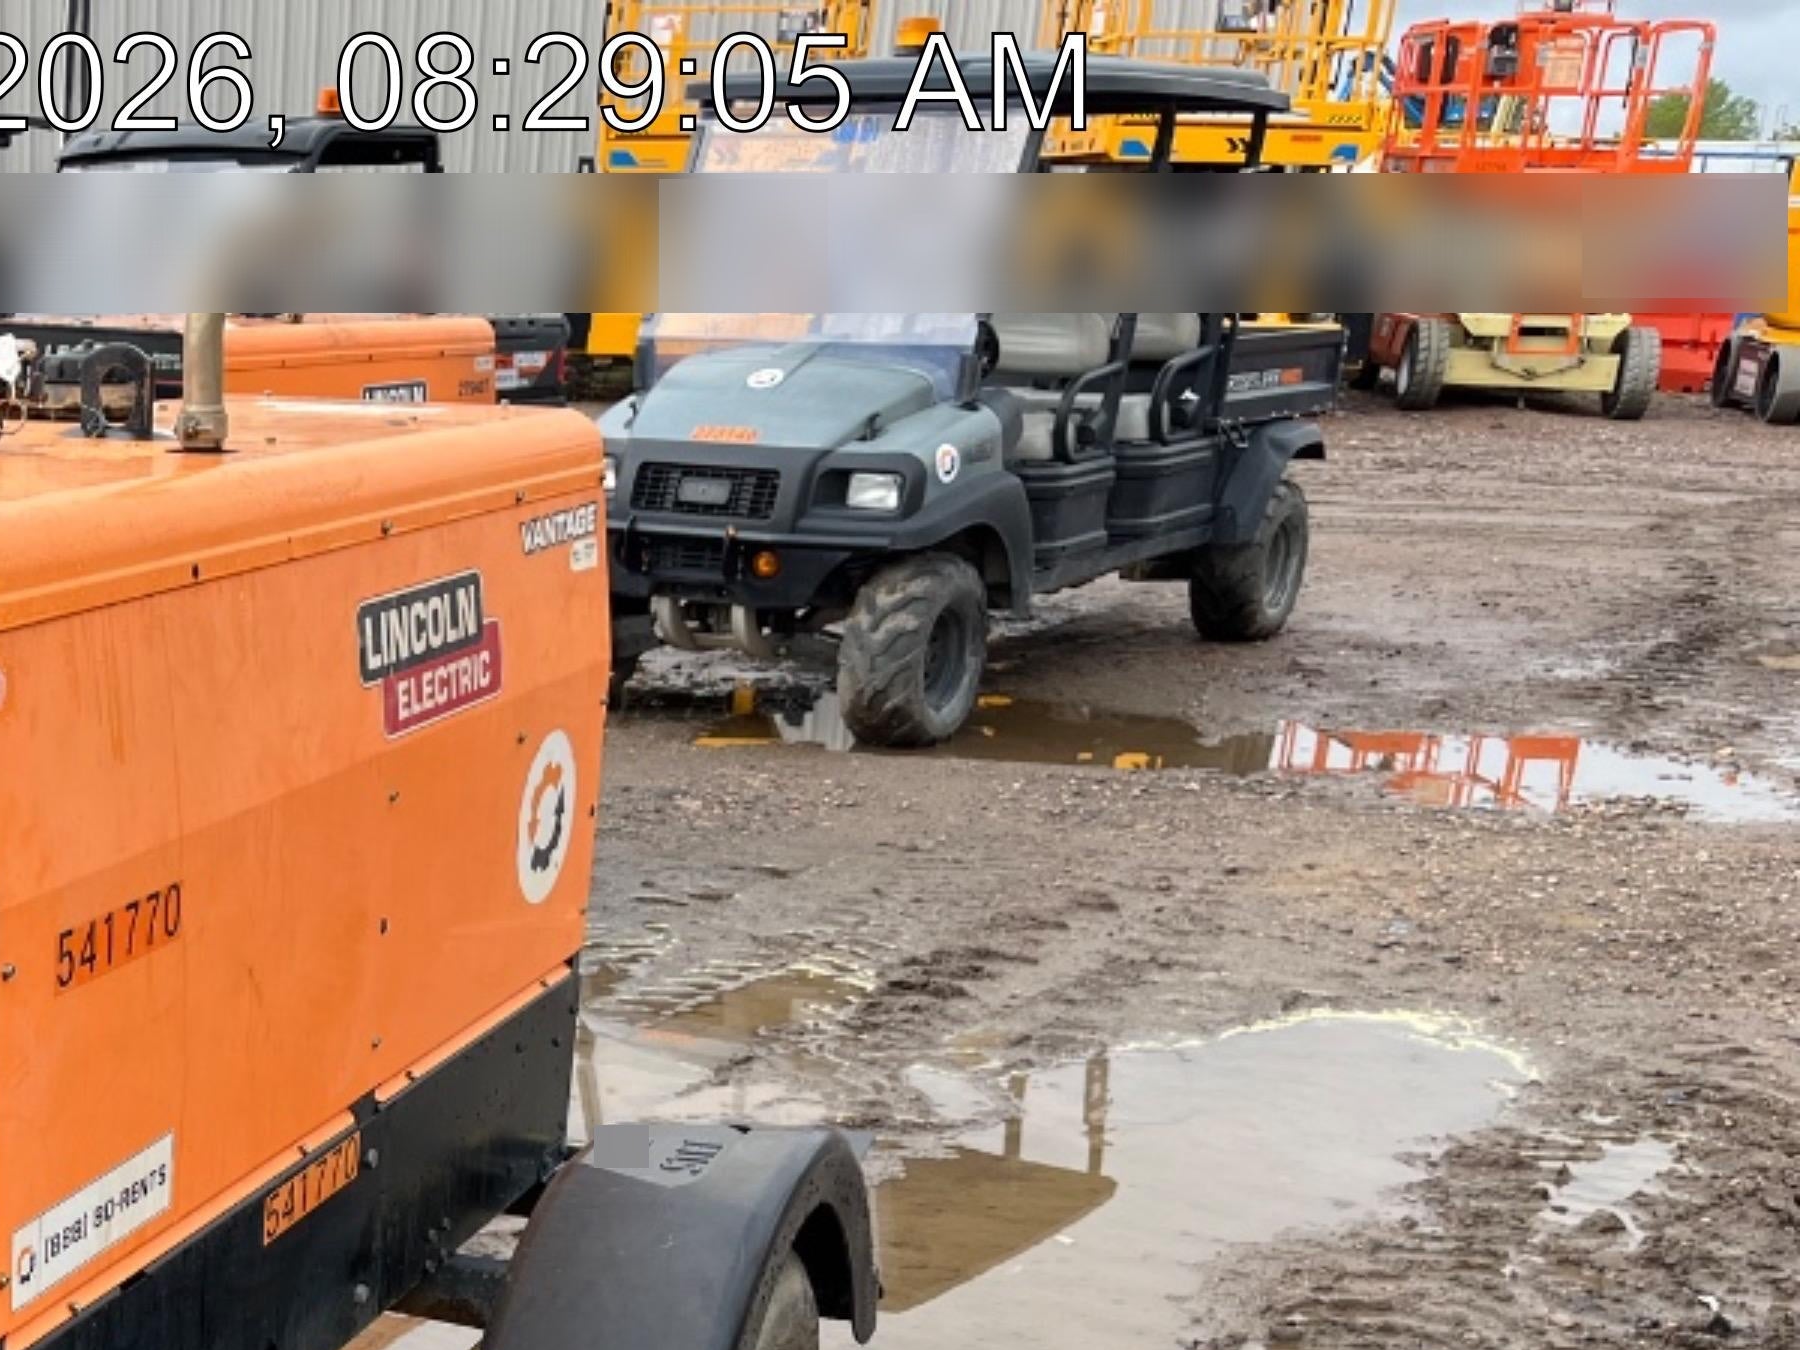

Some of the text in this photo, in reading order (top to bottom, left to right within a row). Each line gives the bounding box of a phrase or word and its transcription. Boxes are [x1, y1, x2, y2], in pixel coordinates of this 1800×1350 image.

[521, 502, 597, 555] VANTAGE
[365, 584, 478, 670] LINCOLN
[396, 650, 491, 721] ELECTRIC
[56, 883, 182, 989] 541770
[92, 1162, 167, 1229] 80-RENTS
[266, 1135, 358, 1238] 541770
